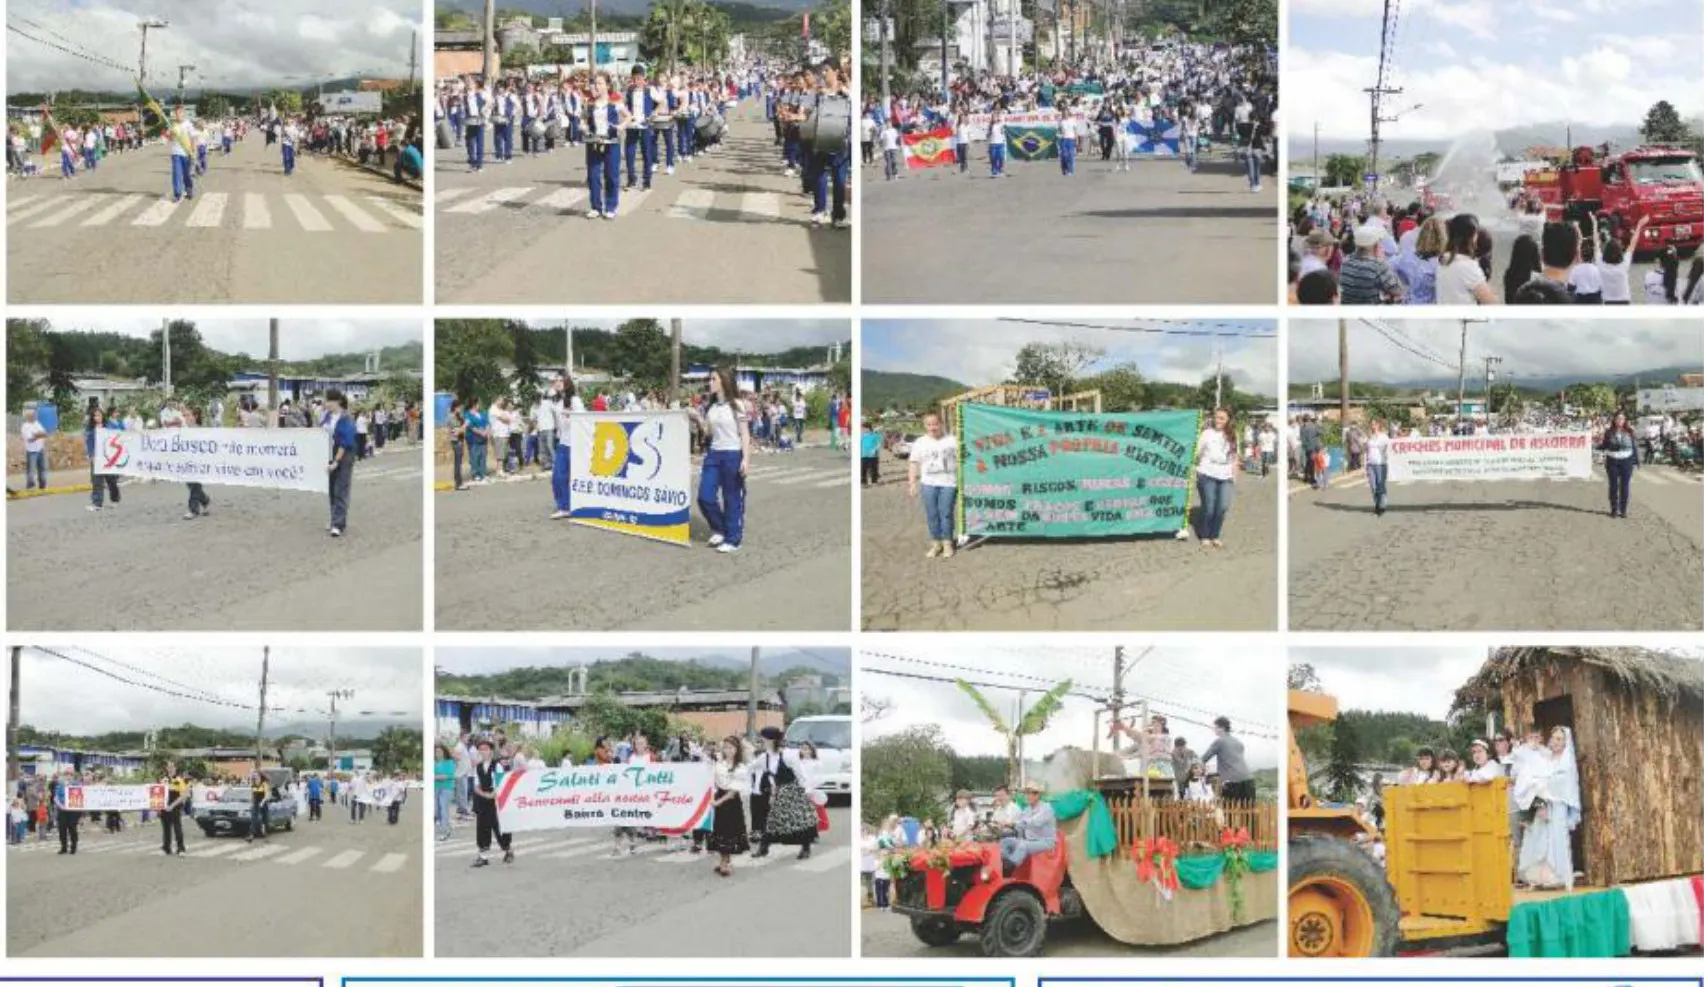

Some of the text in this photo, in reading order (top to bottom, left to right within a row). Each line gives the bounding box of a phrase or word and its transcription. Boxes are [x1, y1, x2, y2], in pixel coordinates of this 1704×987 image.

[1510, 437, 1526, 450] DE
[993, 444, 1048, 469] NOSSA
[598, 481, 650, 501] DOMINGOS
[1021, 480, 1076, 495] RISCOS
[1091, 511, 1122, 522] VIDA
[537, 770, 600, 792] Saluti
[622, 766, 675, 788] Tutti
[611, 807, 653, 820] Centro
